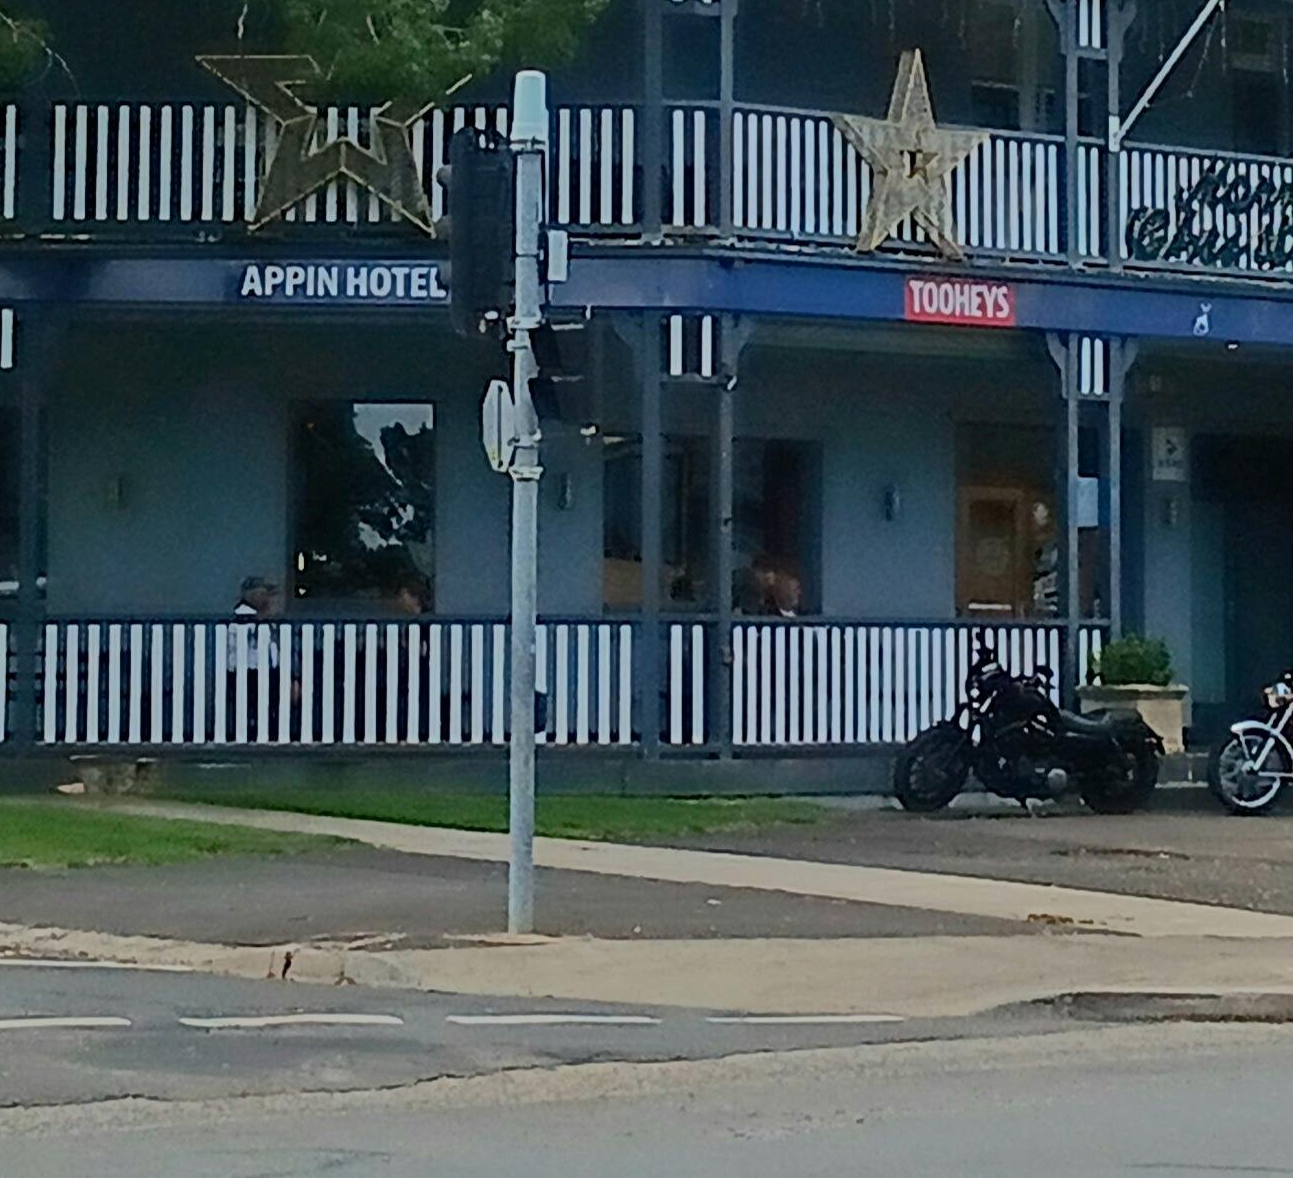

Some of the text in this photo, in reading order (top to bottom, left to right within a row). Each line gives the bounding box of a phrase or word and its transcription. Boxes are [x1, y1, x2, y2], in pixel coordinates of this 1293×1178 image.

[241, 265, 447, 298] APPIN HOTEL
[909, 280, 1010, 318] TOOHEYS
